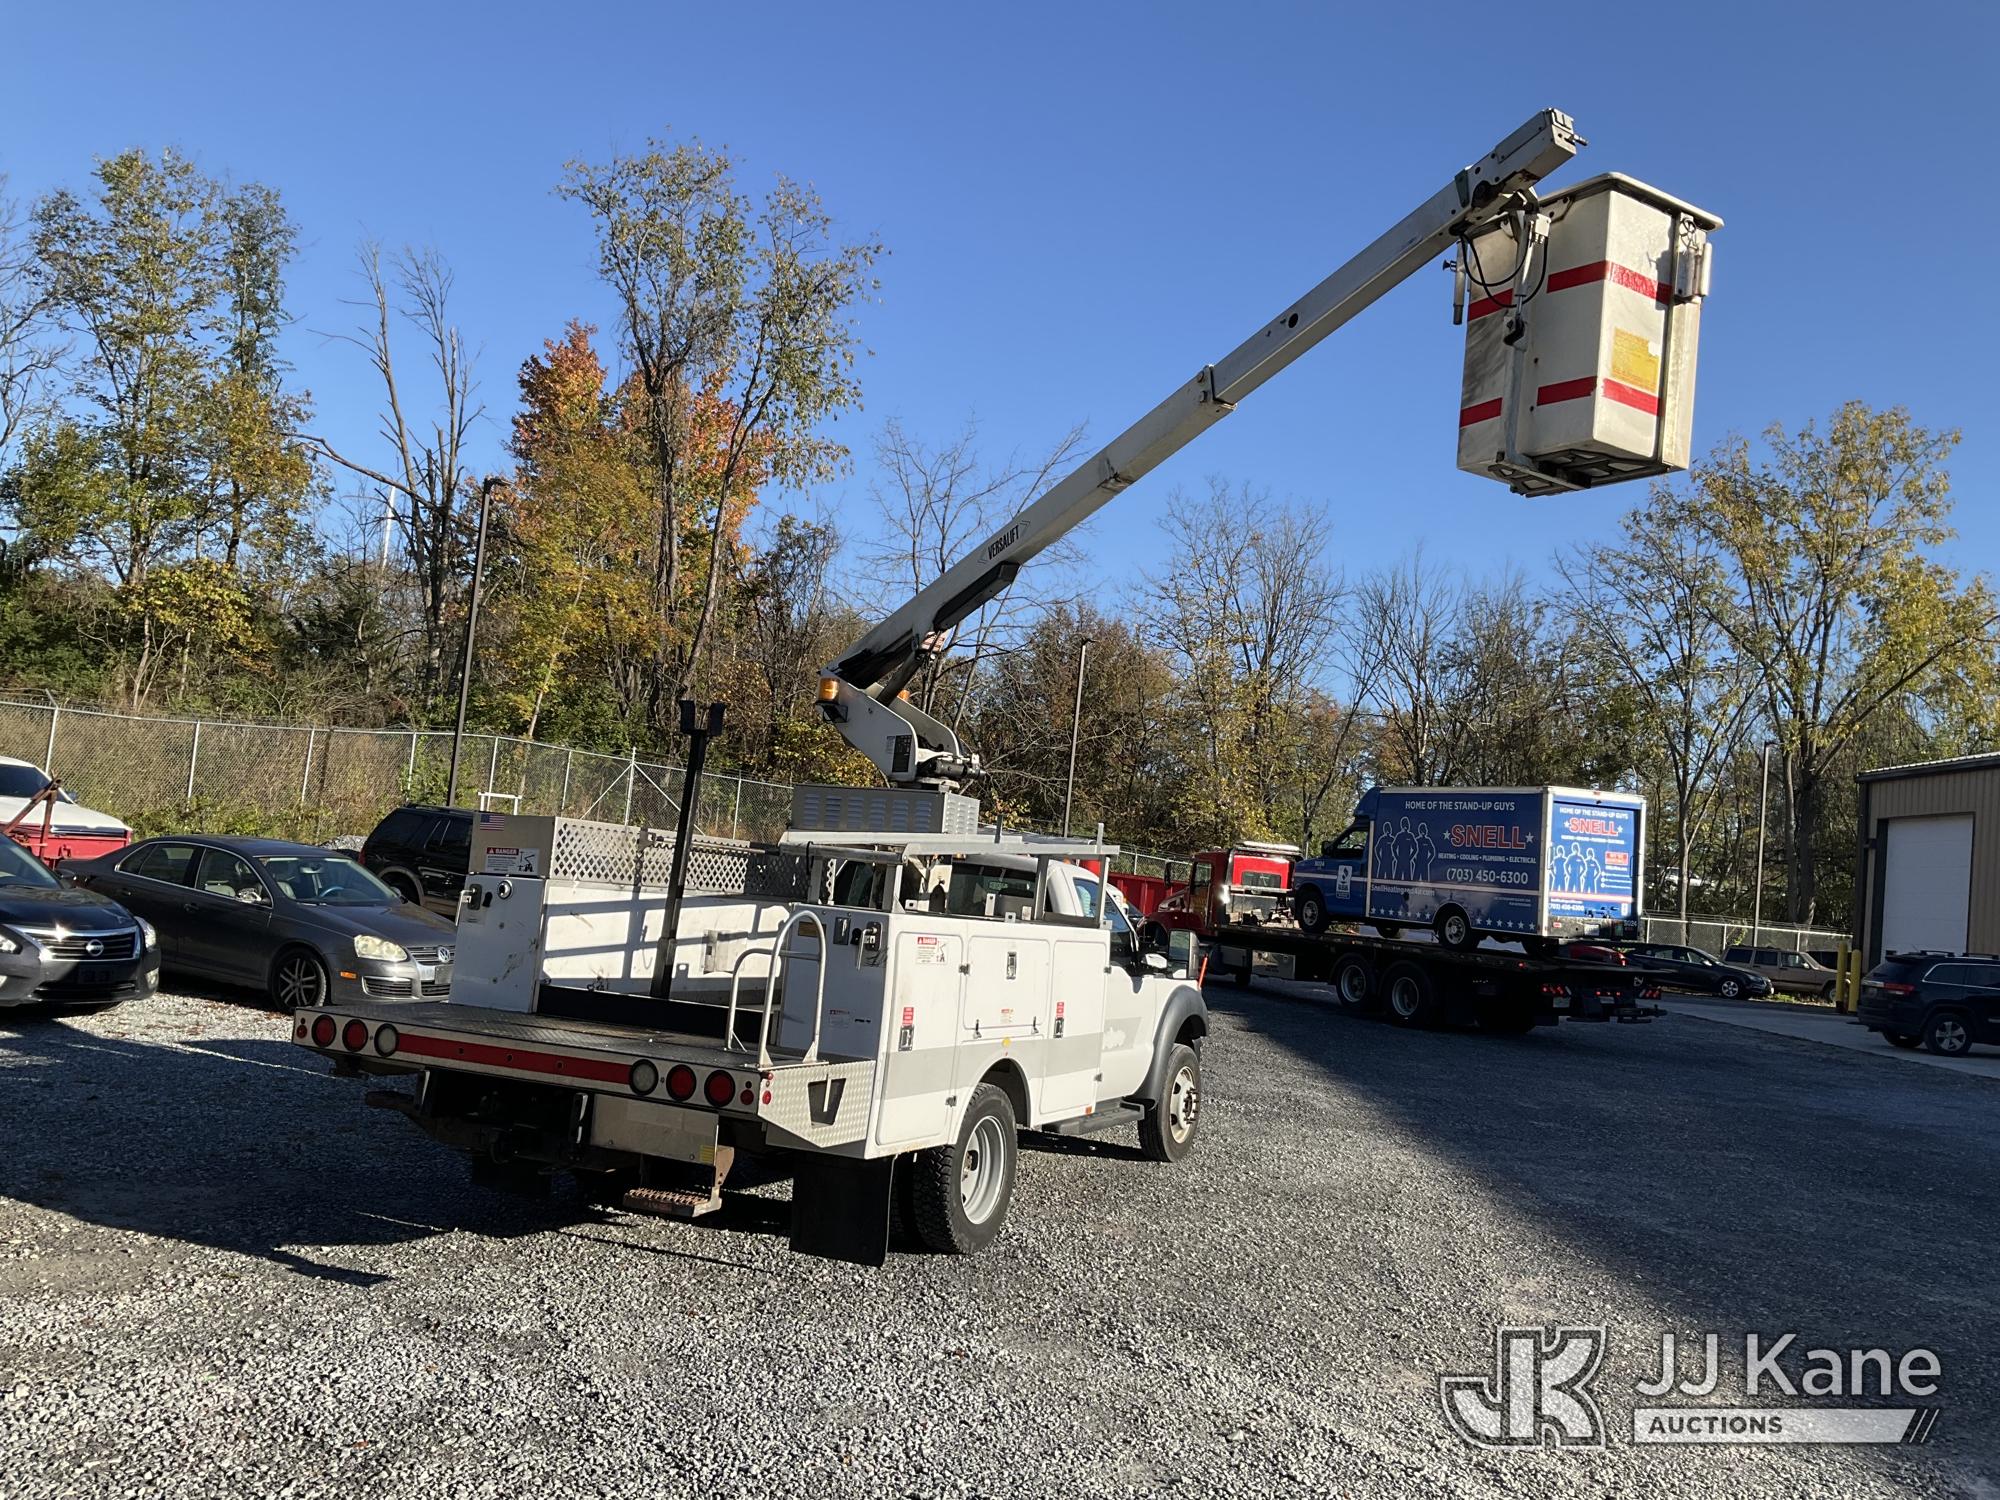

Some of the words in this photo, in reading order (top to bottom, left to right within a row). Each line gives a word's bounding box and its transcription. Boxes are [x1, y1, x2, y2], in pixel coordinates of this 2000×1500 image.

[987, 524, 1019, 560] VERSALIFT
[1405, 801, 1426, 810] HOME
[1427, 801, 1437, 810] OF
[1438, 802, 1453, 810] THE
[1454, 802, 1492, 811] STAND-UP
[1493, 802, 1515, 811] GUYS
[1569, 817, 1619, 837] SNELL
[1450, 824, 1526, 850] SNELL
[1459, 853, 1479, 861] COOLING
[1508, 856, 1537, 864] ELECTRICAL
[1446, 868, 1474, 883] (703)
[1475, 868, 1529, 885] 450-6300
